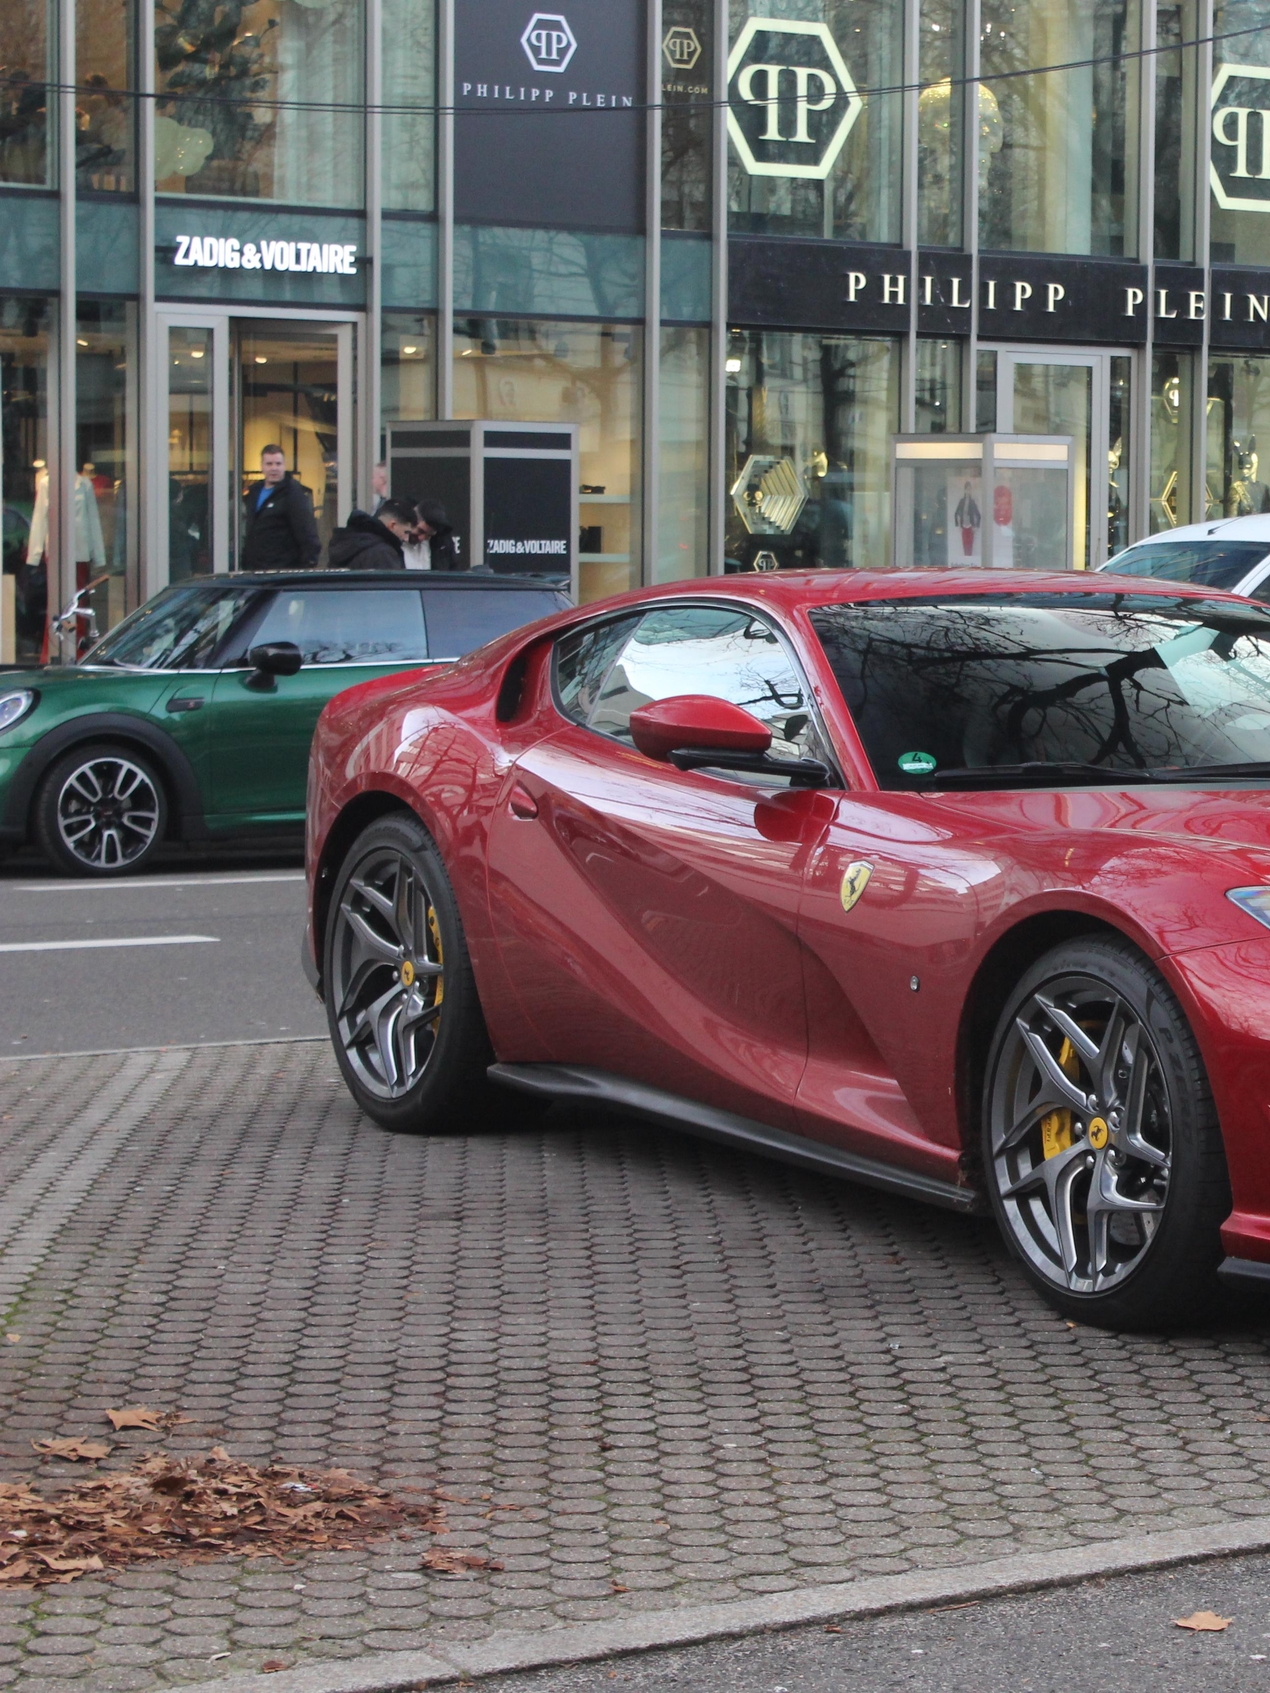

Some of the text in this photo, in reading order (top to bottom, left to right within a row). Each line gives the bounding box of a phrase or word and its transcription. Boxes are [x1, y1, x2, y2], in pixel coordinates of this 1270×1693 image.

[462, 82, 634, 108] PHILIPP PLEIN
[661, 84, 709, 95] LEIN.COM
[846, 271, 1270, 323] PHILIPP PLEIN
